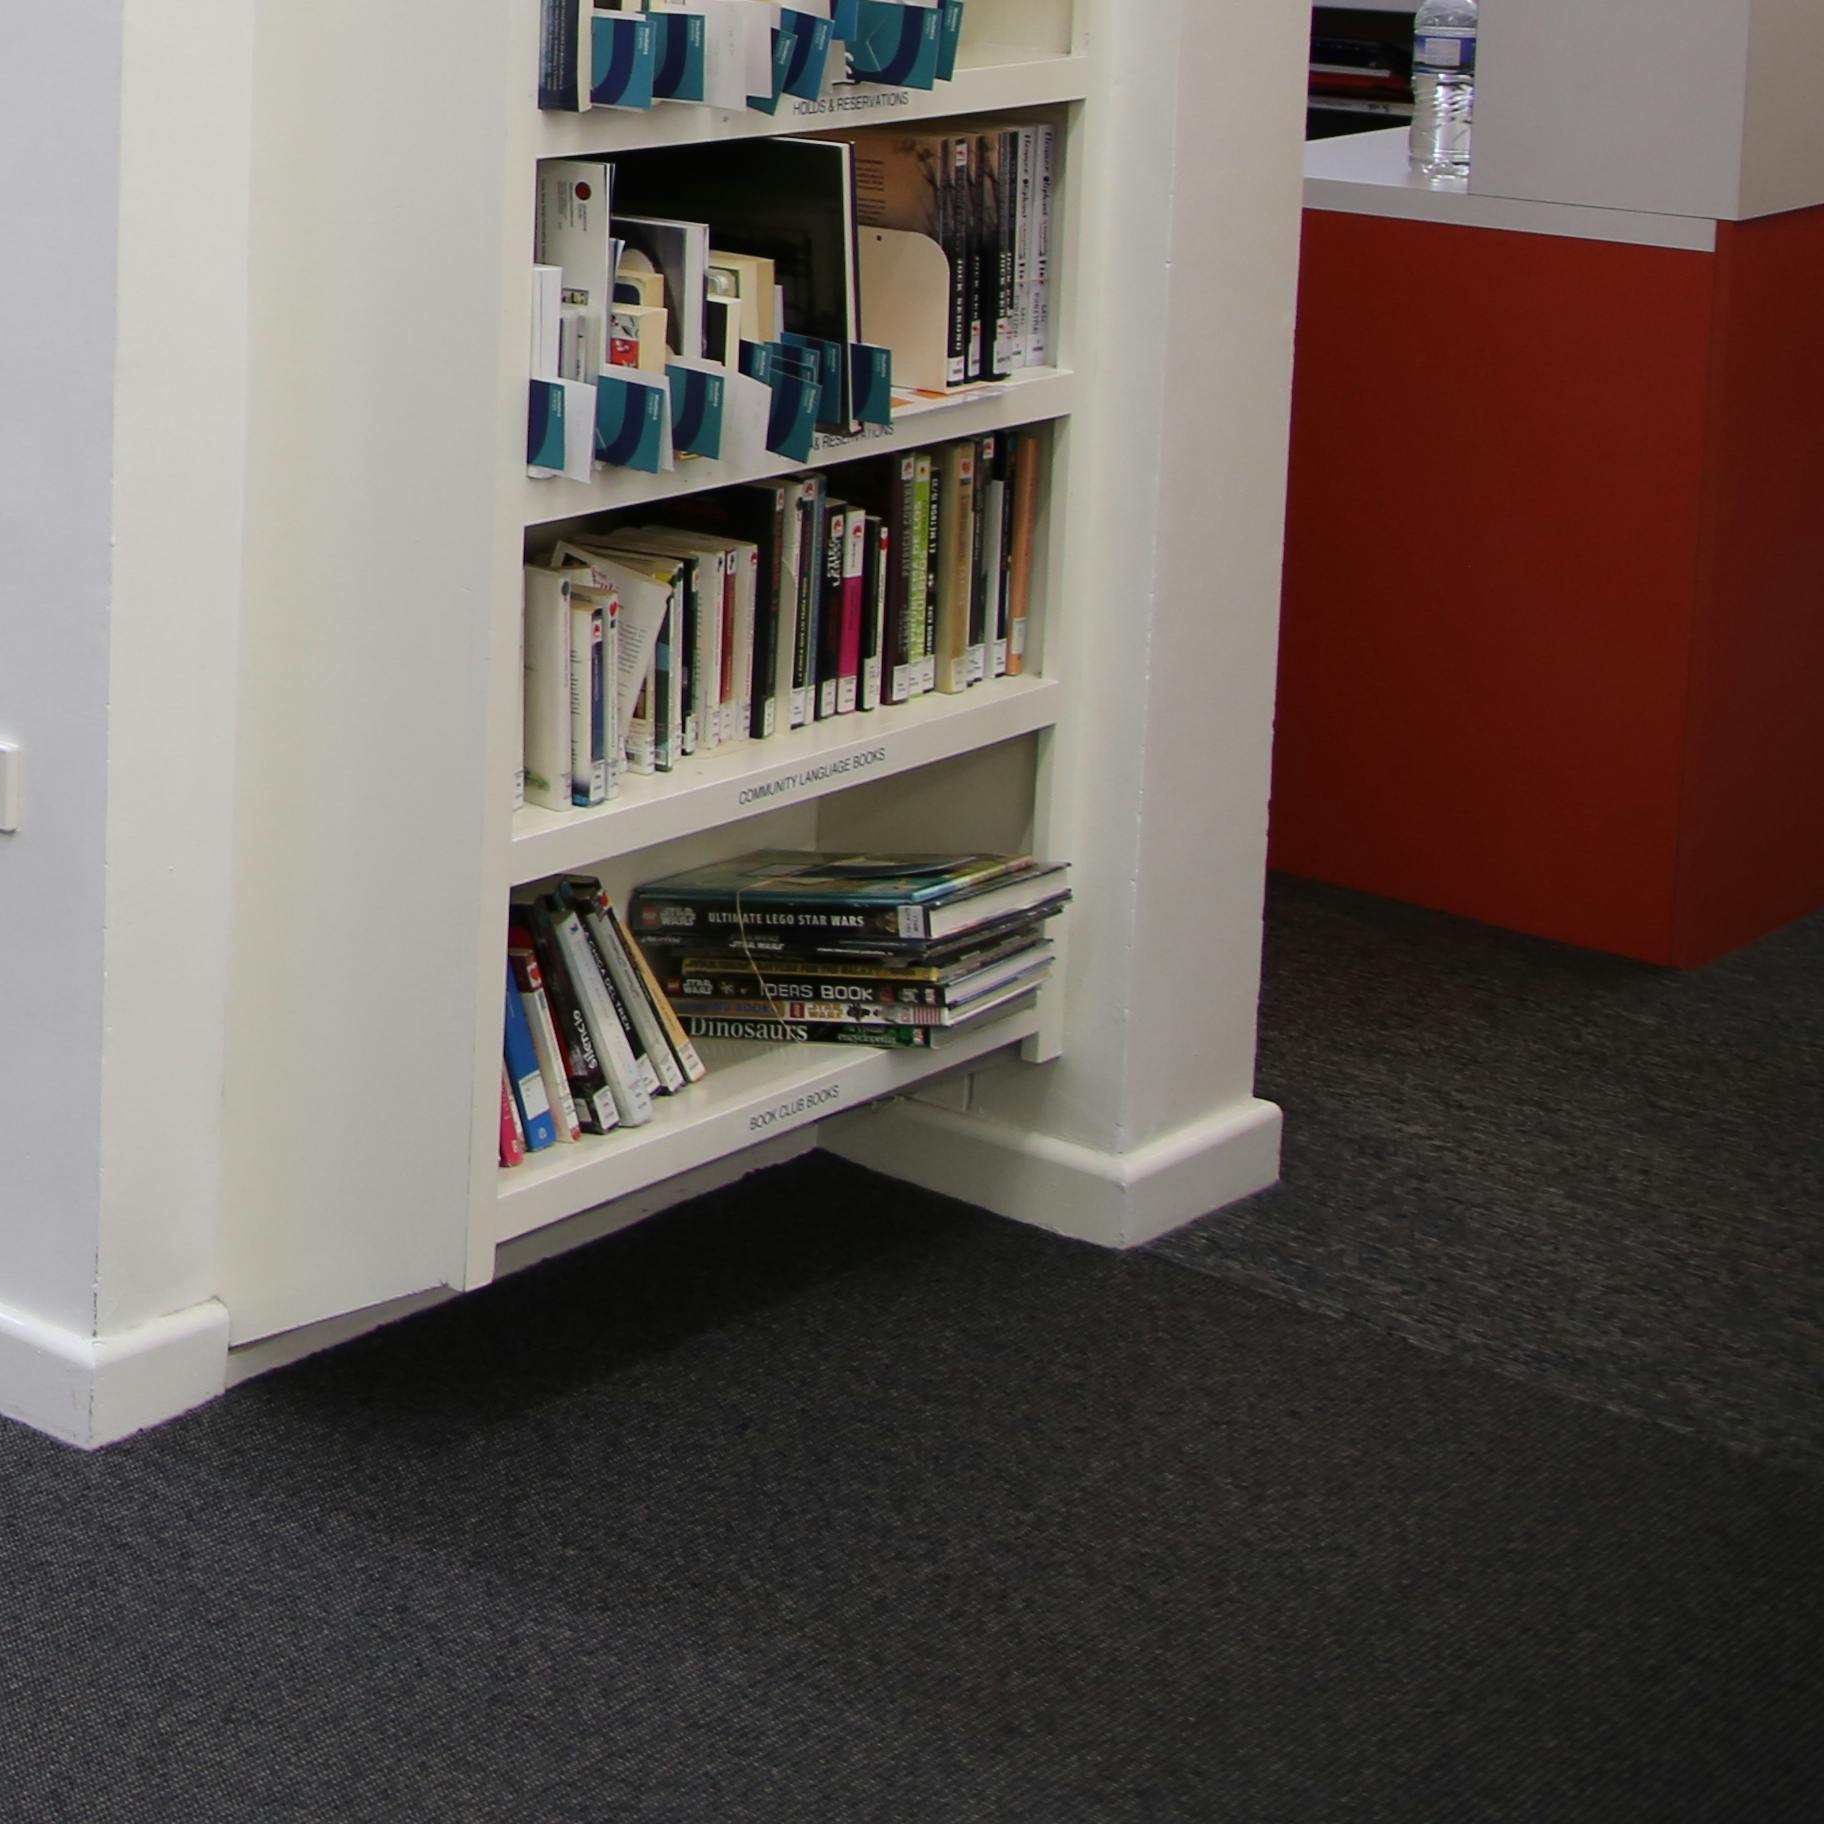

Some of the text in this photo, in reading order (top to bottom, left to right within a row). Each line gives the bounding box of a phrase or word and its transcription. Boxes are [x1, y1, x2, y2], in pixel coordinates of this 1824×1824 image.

[793, 91, 909, 117] HOLDS & RESERVATIONS
[739, 747, 886, 805] COMMUNITY LANGUAGE BOOKS
[765, 914, 795, 925] LEGO
[798, 915, 828, 926] STAR
[830, 916, 865, 927] WARS
[820, 985, 873, 1001] BOOK
[572, 1009, 599, 1070] silencio
[691, 1017, 808, 1042] Dinosaurs
[749, 1084, 841, 1132] BOOK CLUB BOOKS
